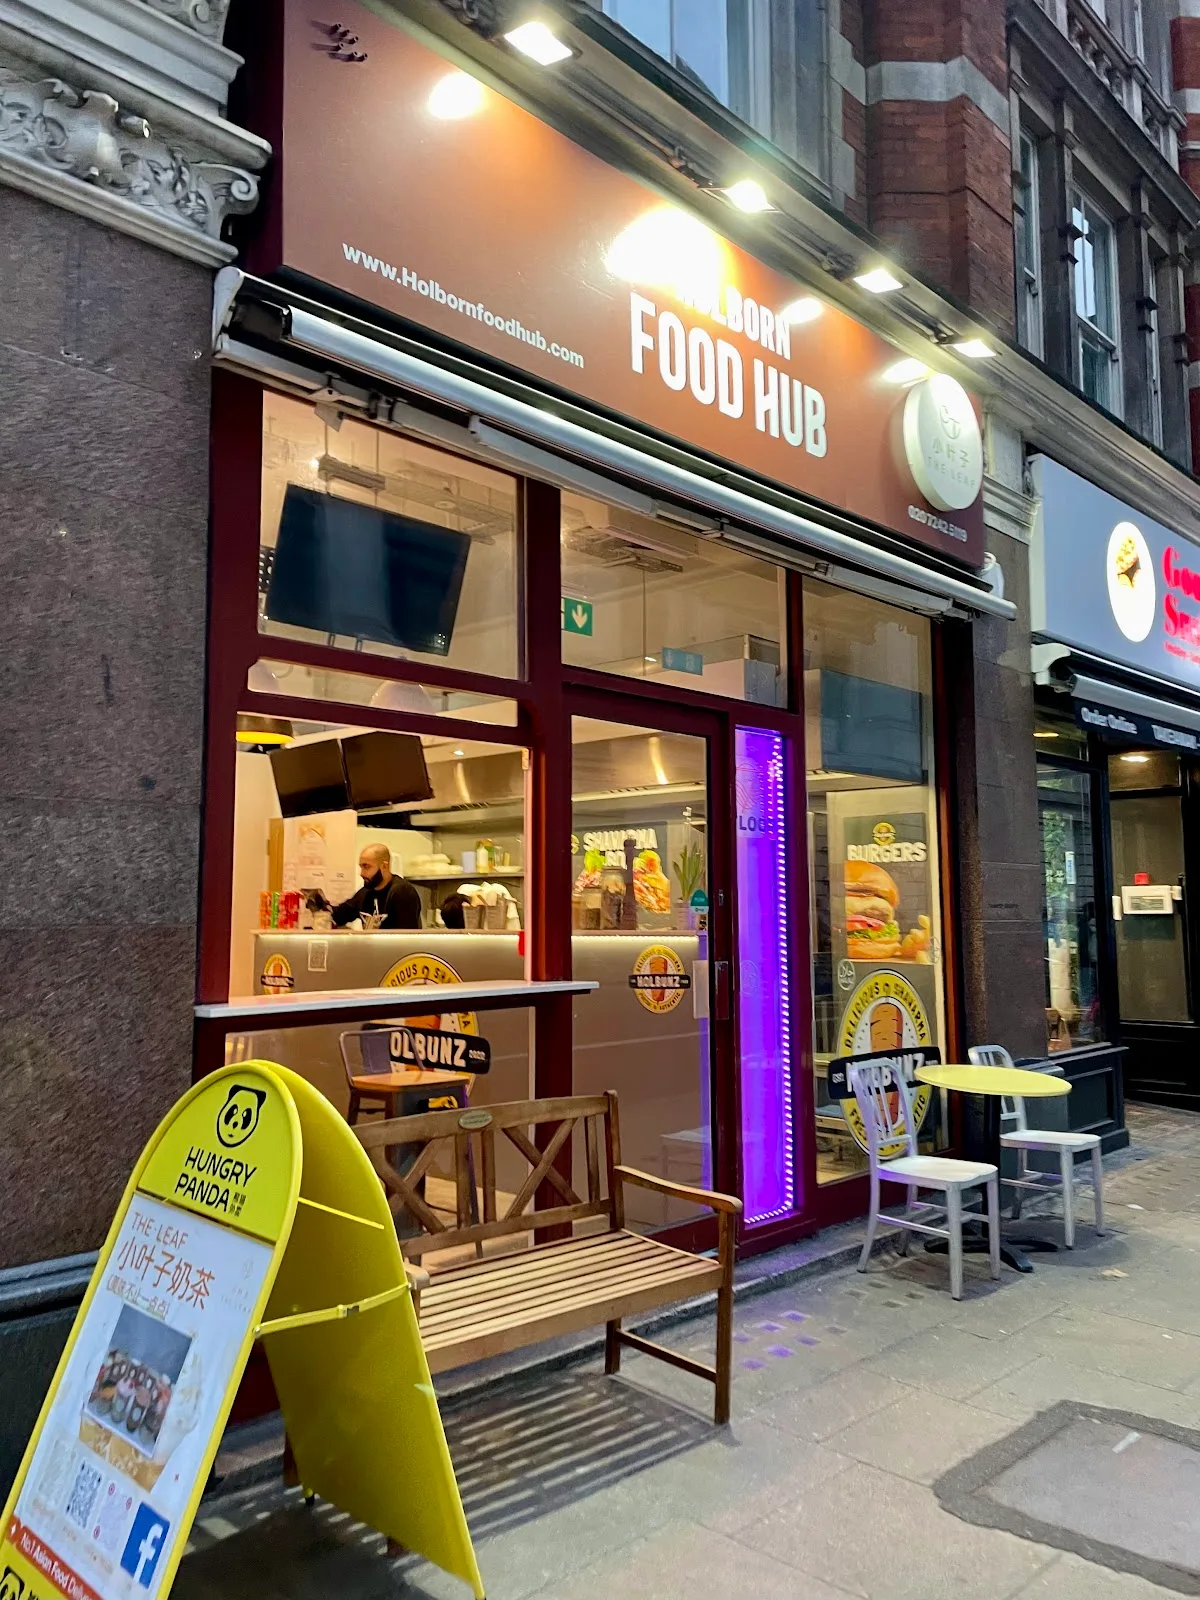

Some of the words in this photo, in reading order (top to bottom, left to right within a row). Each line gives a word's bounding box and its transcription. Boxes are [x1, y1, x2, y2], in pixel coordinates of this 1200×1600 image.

[341, 241, 585, 369] www.Holbornfoodhub.com
[629, 290, 745, 420] FOOD
[752, 357, 828, 459] HUB
[847, 841, 927, 863] BURGERS
[844, 981, 880, 1050] DELICIOUS
[389, 1031, 467, 1068] OLBUNZ
[184, 1146, 258, 1188] HUNGRY
[174, 1173, 230, 1213] PANDA
[117, 1236, 216, 1311] 小叶子奶茶
[32, 1544, 53, 1573] Asian
[50, 1560, 70, 1589] Food
